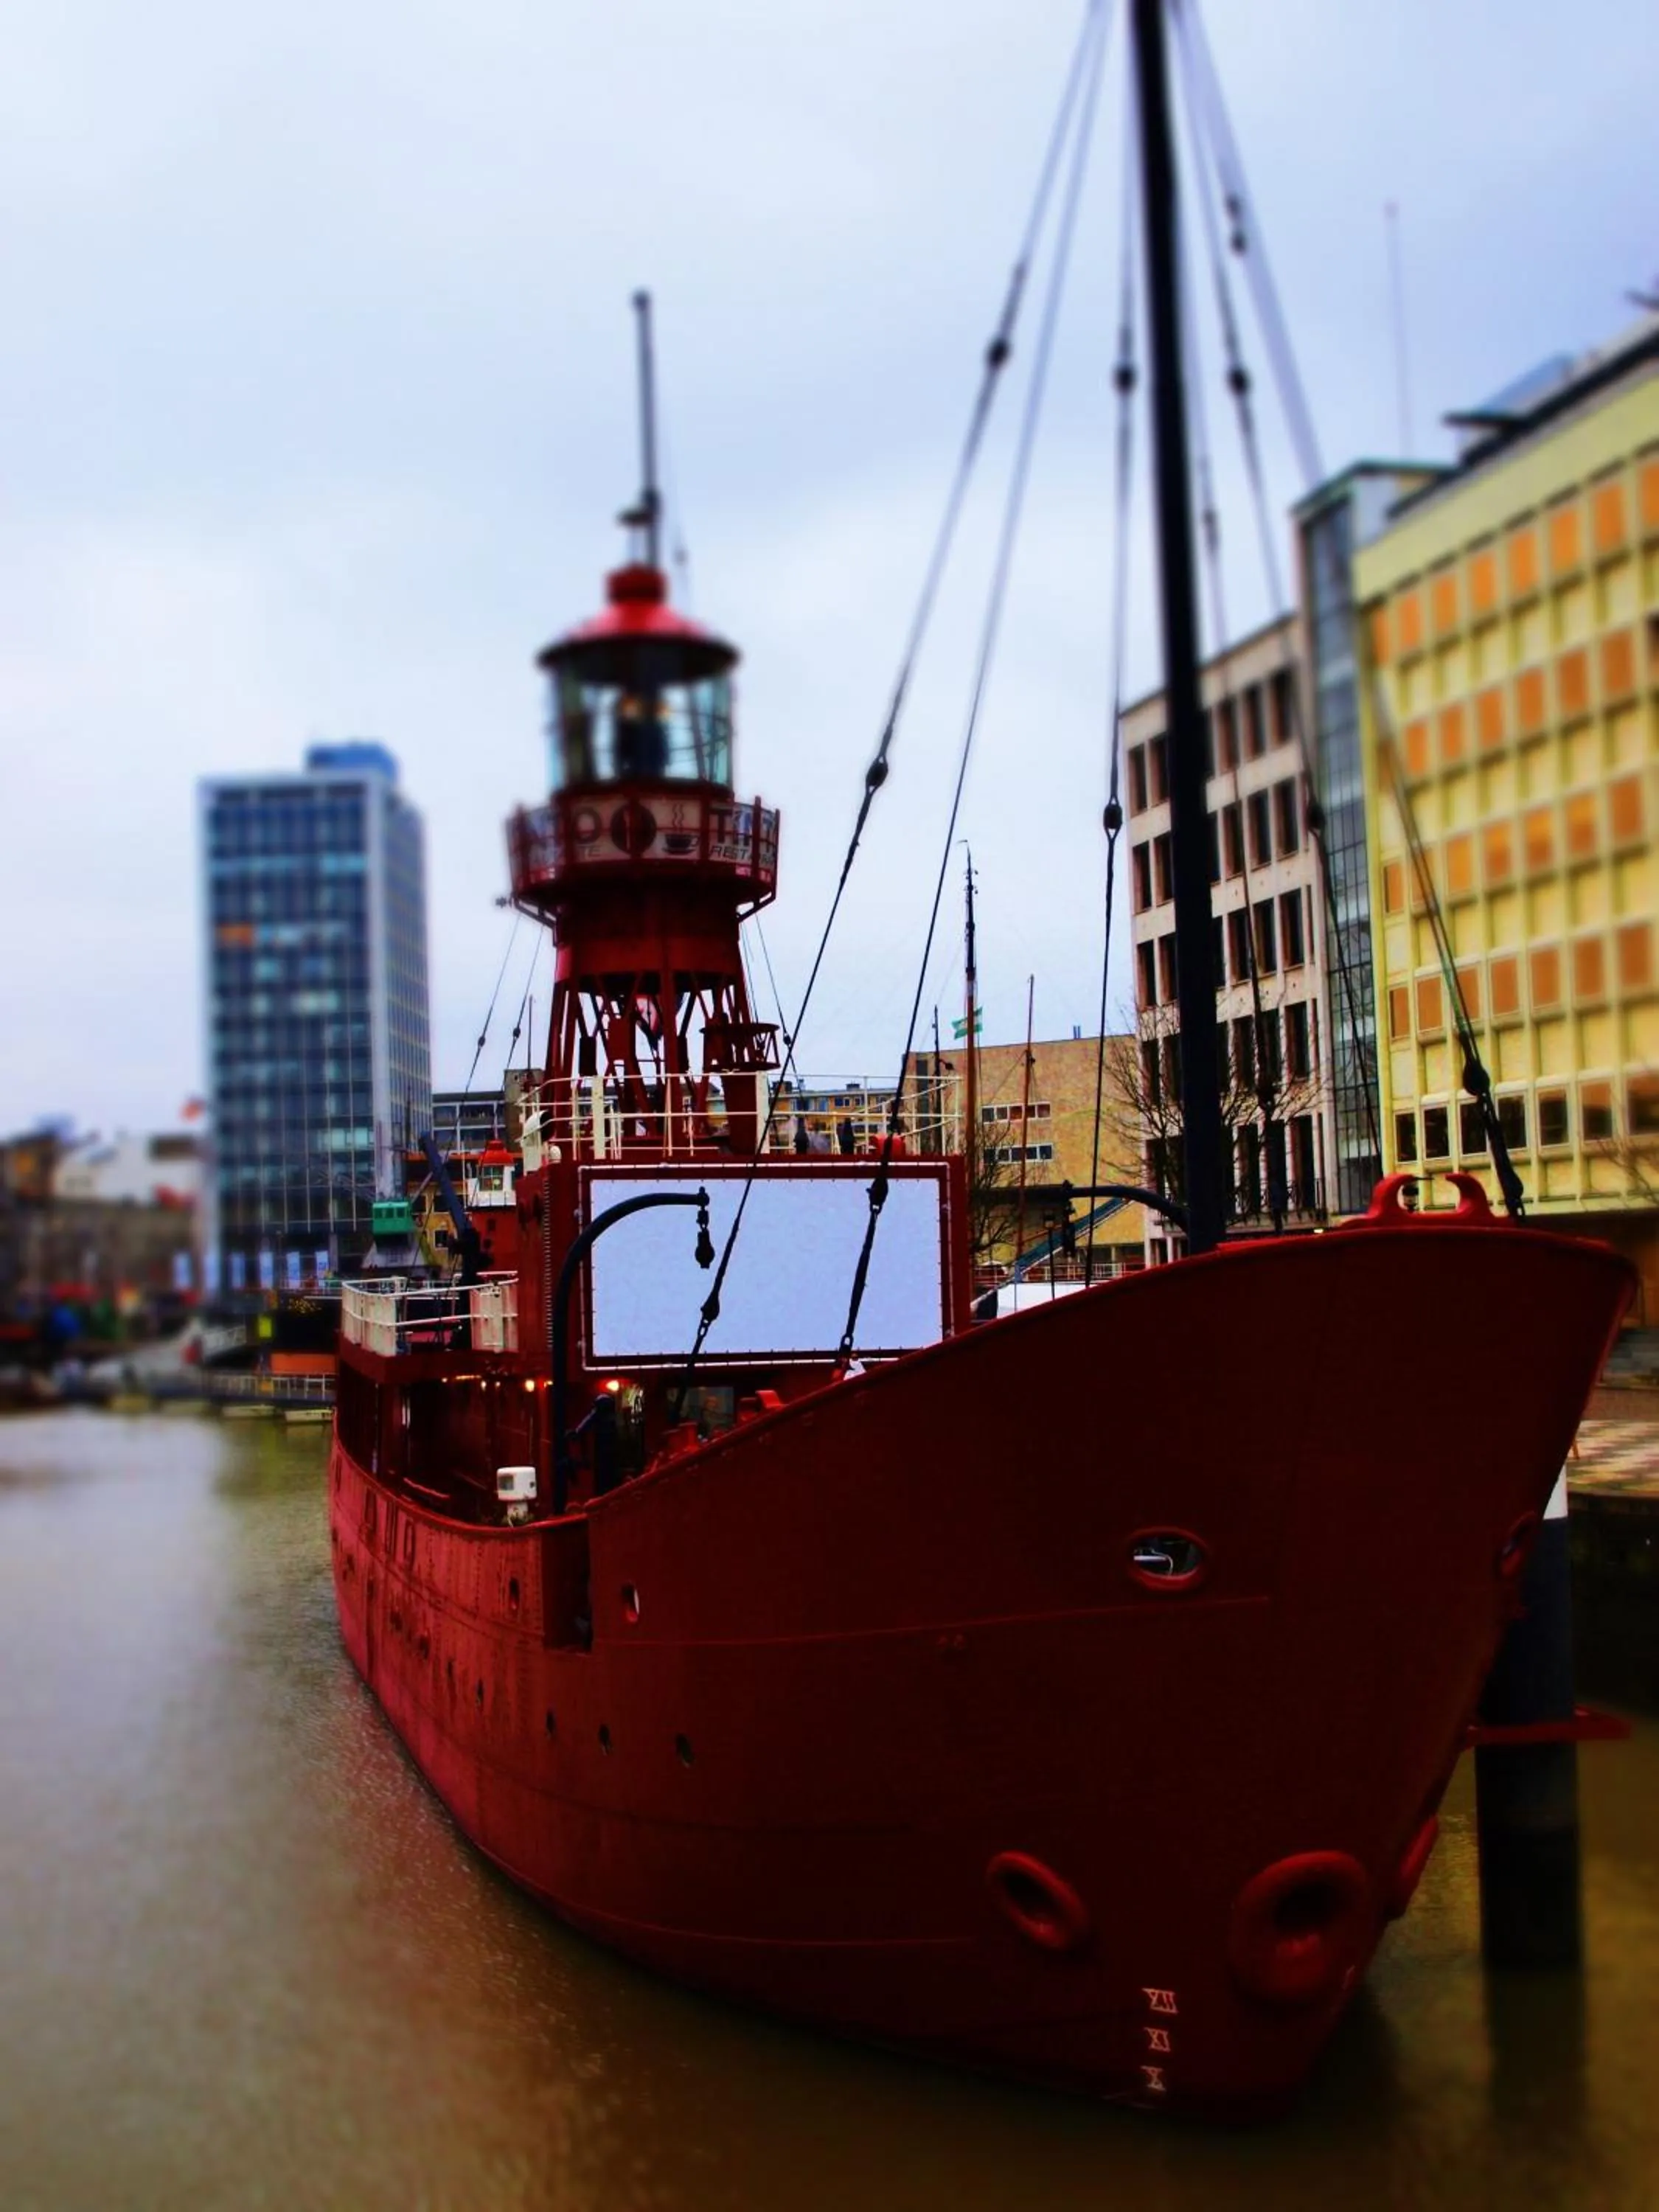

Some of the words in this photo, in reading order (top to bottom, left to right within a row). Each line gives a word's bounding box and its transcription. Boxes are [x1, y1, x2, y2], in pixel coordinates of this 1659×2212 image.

[1141, 1987, 1179, 2014] XII
[1144, 2027, 1171, 2053] XI
[1141, 2065, 1166, 2091] X
